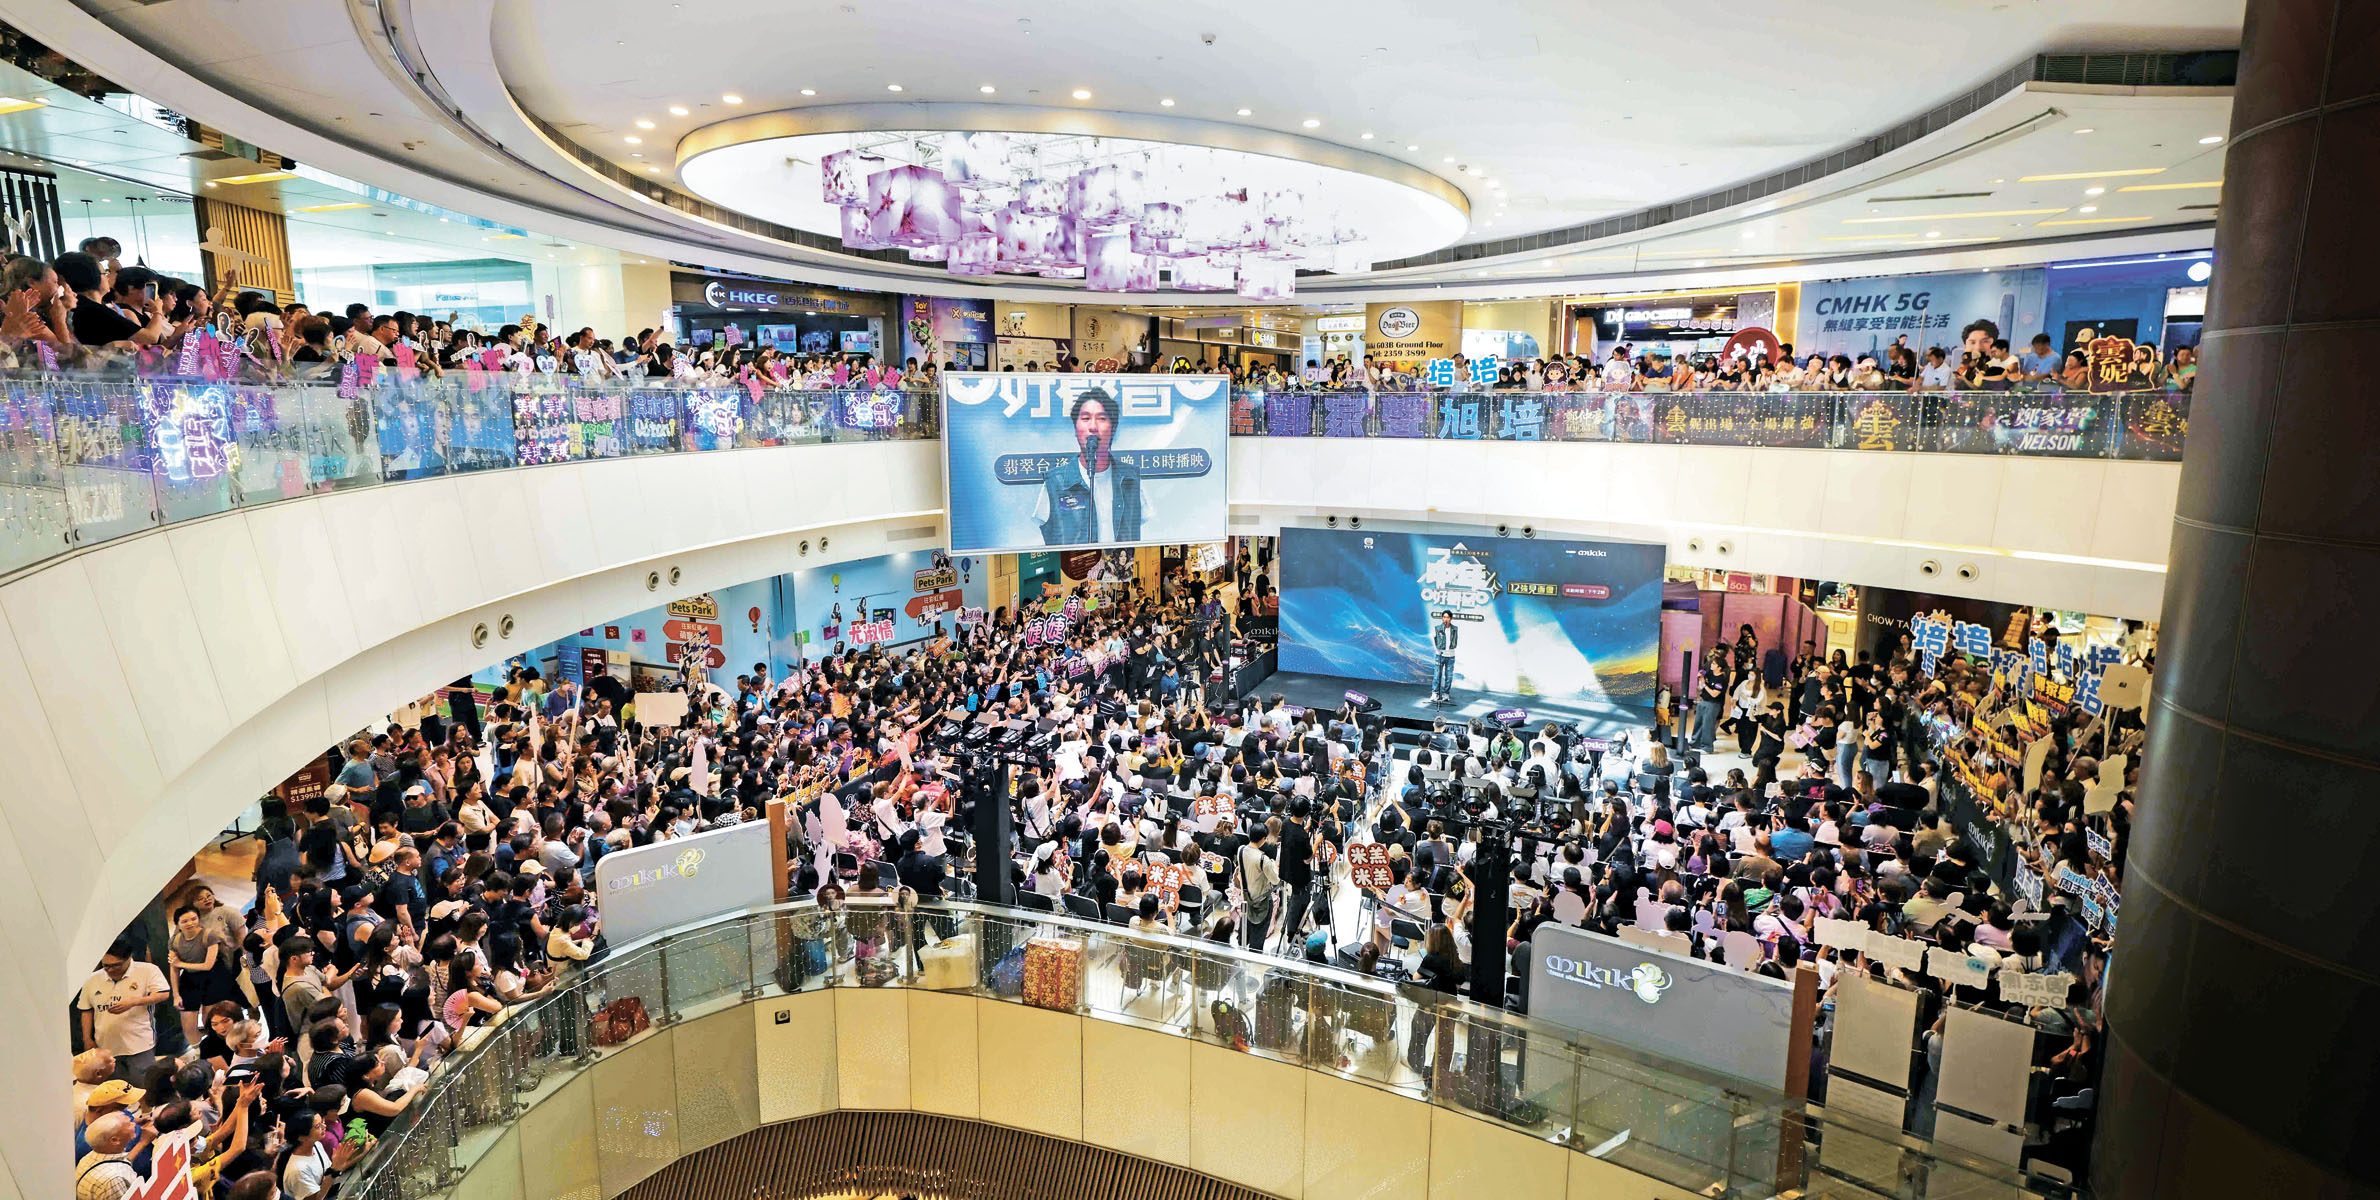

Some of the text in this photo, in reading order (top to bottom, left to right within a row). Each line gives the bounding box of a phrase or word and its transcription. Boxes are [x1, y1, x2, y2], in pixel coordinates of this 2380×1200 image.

[729, 291, 778, 305] HKEC
[1816, 292, 1930, 315] CMHK 5G
[1823, 312, 1950, 333] 無縫享受智能生活
[1396, 341, 1423, 349] Ground
[1426, 341, 1444, 349] Floor
[1428, 360, 1454, 385] 培
[1471, 357, 1498, 383] 培
[2096, 343, 2127, 384] 雲妮
[2018, 433, 2083, 451] NELSON
[1003, 458, 1050, 476] 翡翠台
[1577, 549, 1607, 558] mikiki
[918, 575, 953, 588] Pets Park
[672, 602, 713, 615] Pets Park
[1867, 613, 1911, 630] CHOW TA
[849, 620, 893, 645] 尤淑情
[1914, 622, 1947, 656] 培
[1954, 622, 1990, 656] 培
[2029, 638, 2046, 674] 培
[2056, 640, 2073, 678] 培
[1498, 711, 1526, 721] mikiki
[1350, 846, 1389, 865] 米羔
[1354, 867, 1391, 887] 米羔
[2062, 868, 2094, 888] Daniel
